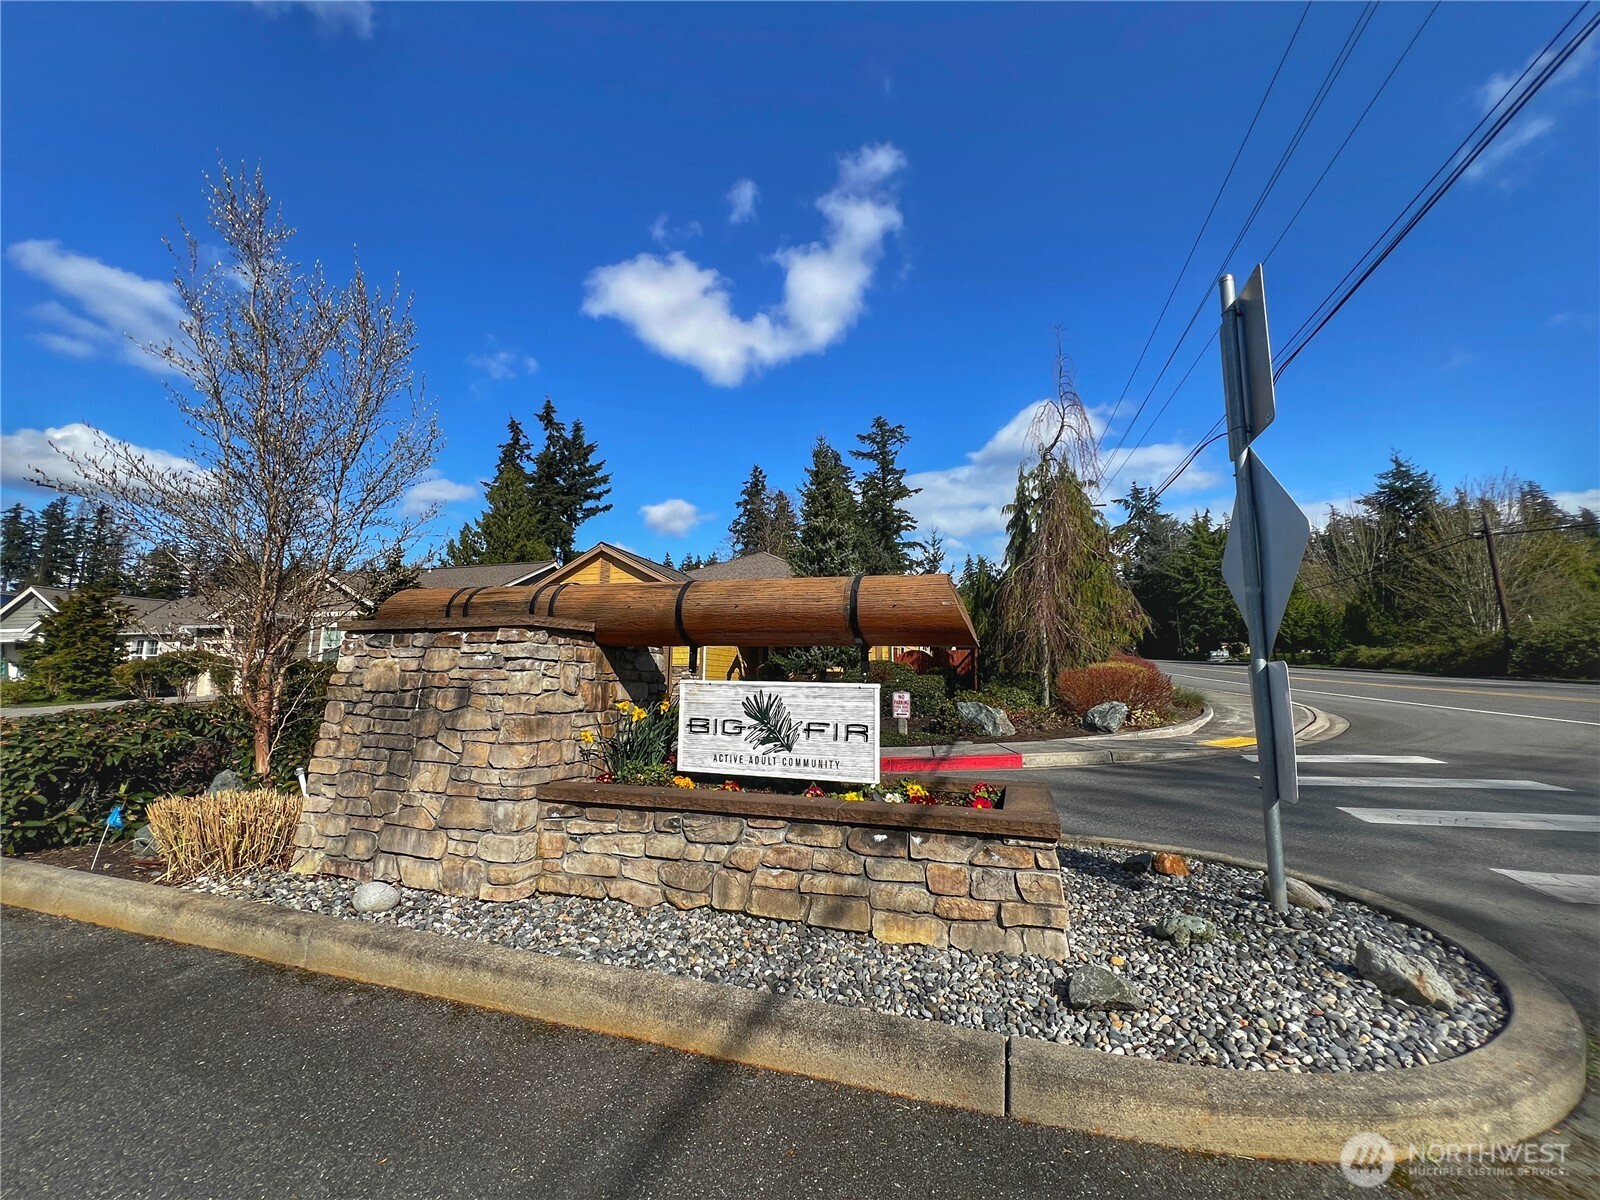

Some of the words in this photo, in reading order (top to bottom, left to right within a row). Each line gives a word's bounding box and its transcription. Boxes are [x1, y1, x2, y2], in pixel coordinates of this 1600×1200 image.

[687, 718, 746, 736] BIG
[803, 722, 869, 743] FIR
[713, 754, 743, 764] ACTIVE
[748, 756, 777, 766] ADULT
[782, 757, 841, 770] COMMUNITY
